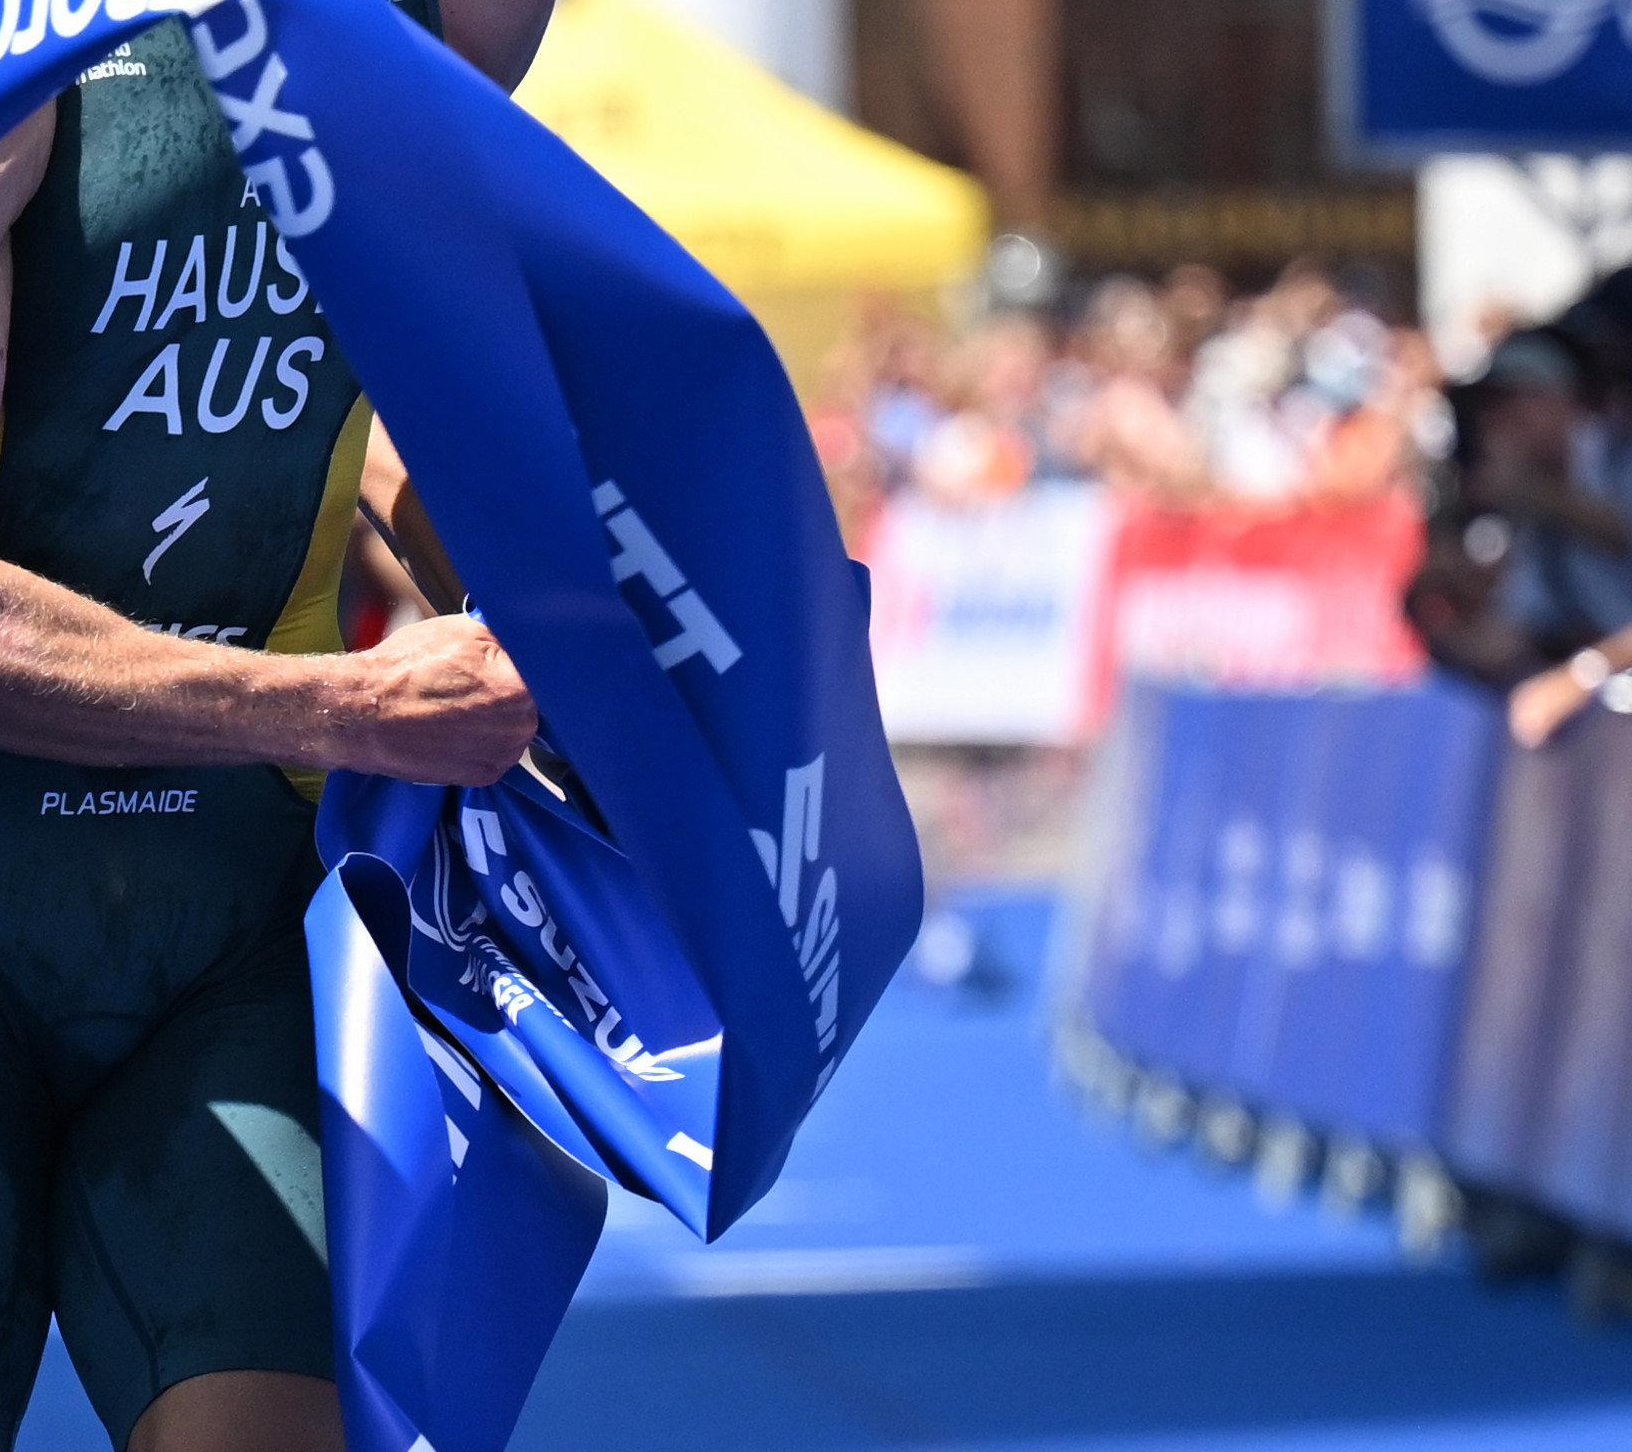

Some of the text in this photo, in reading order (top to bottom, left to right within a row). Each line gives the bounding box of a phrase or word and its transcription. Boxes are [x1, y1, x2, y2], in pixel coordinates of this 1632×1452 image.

[90, 220, 324, 335] HAUS
[102, 335, 326, 436] AUS
[40, 789, 199, 816] PLASMAIDE
